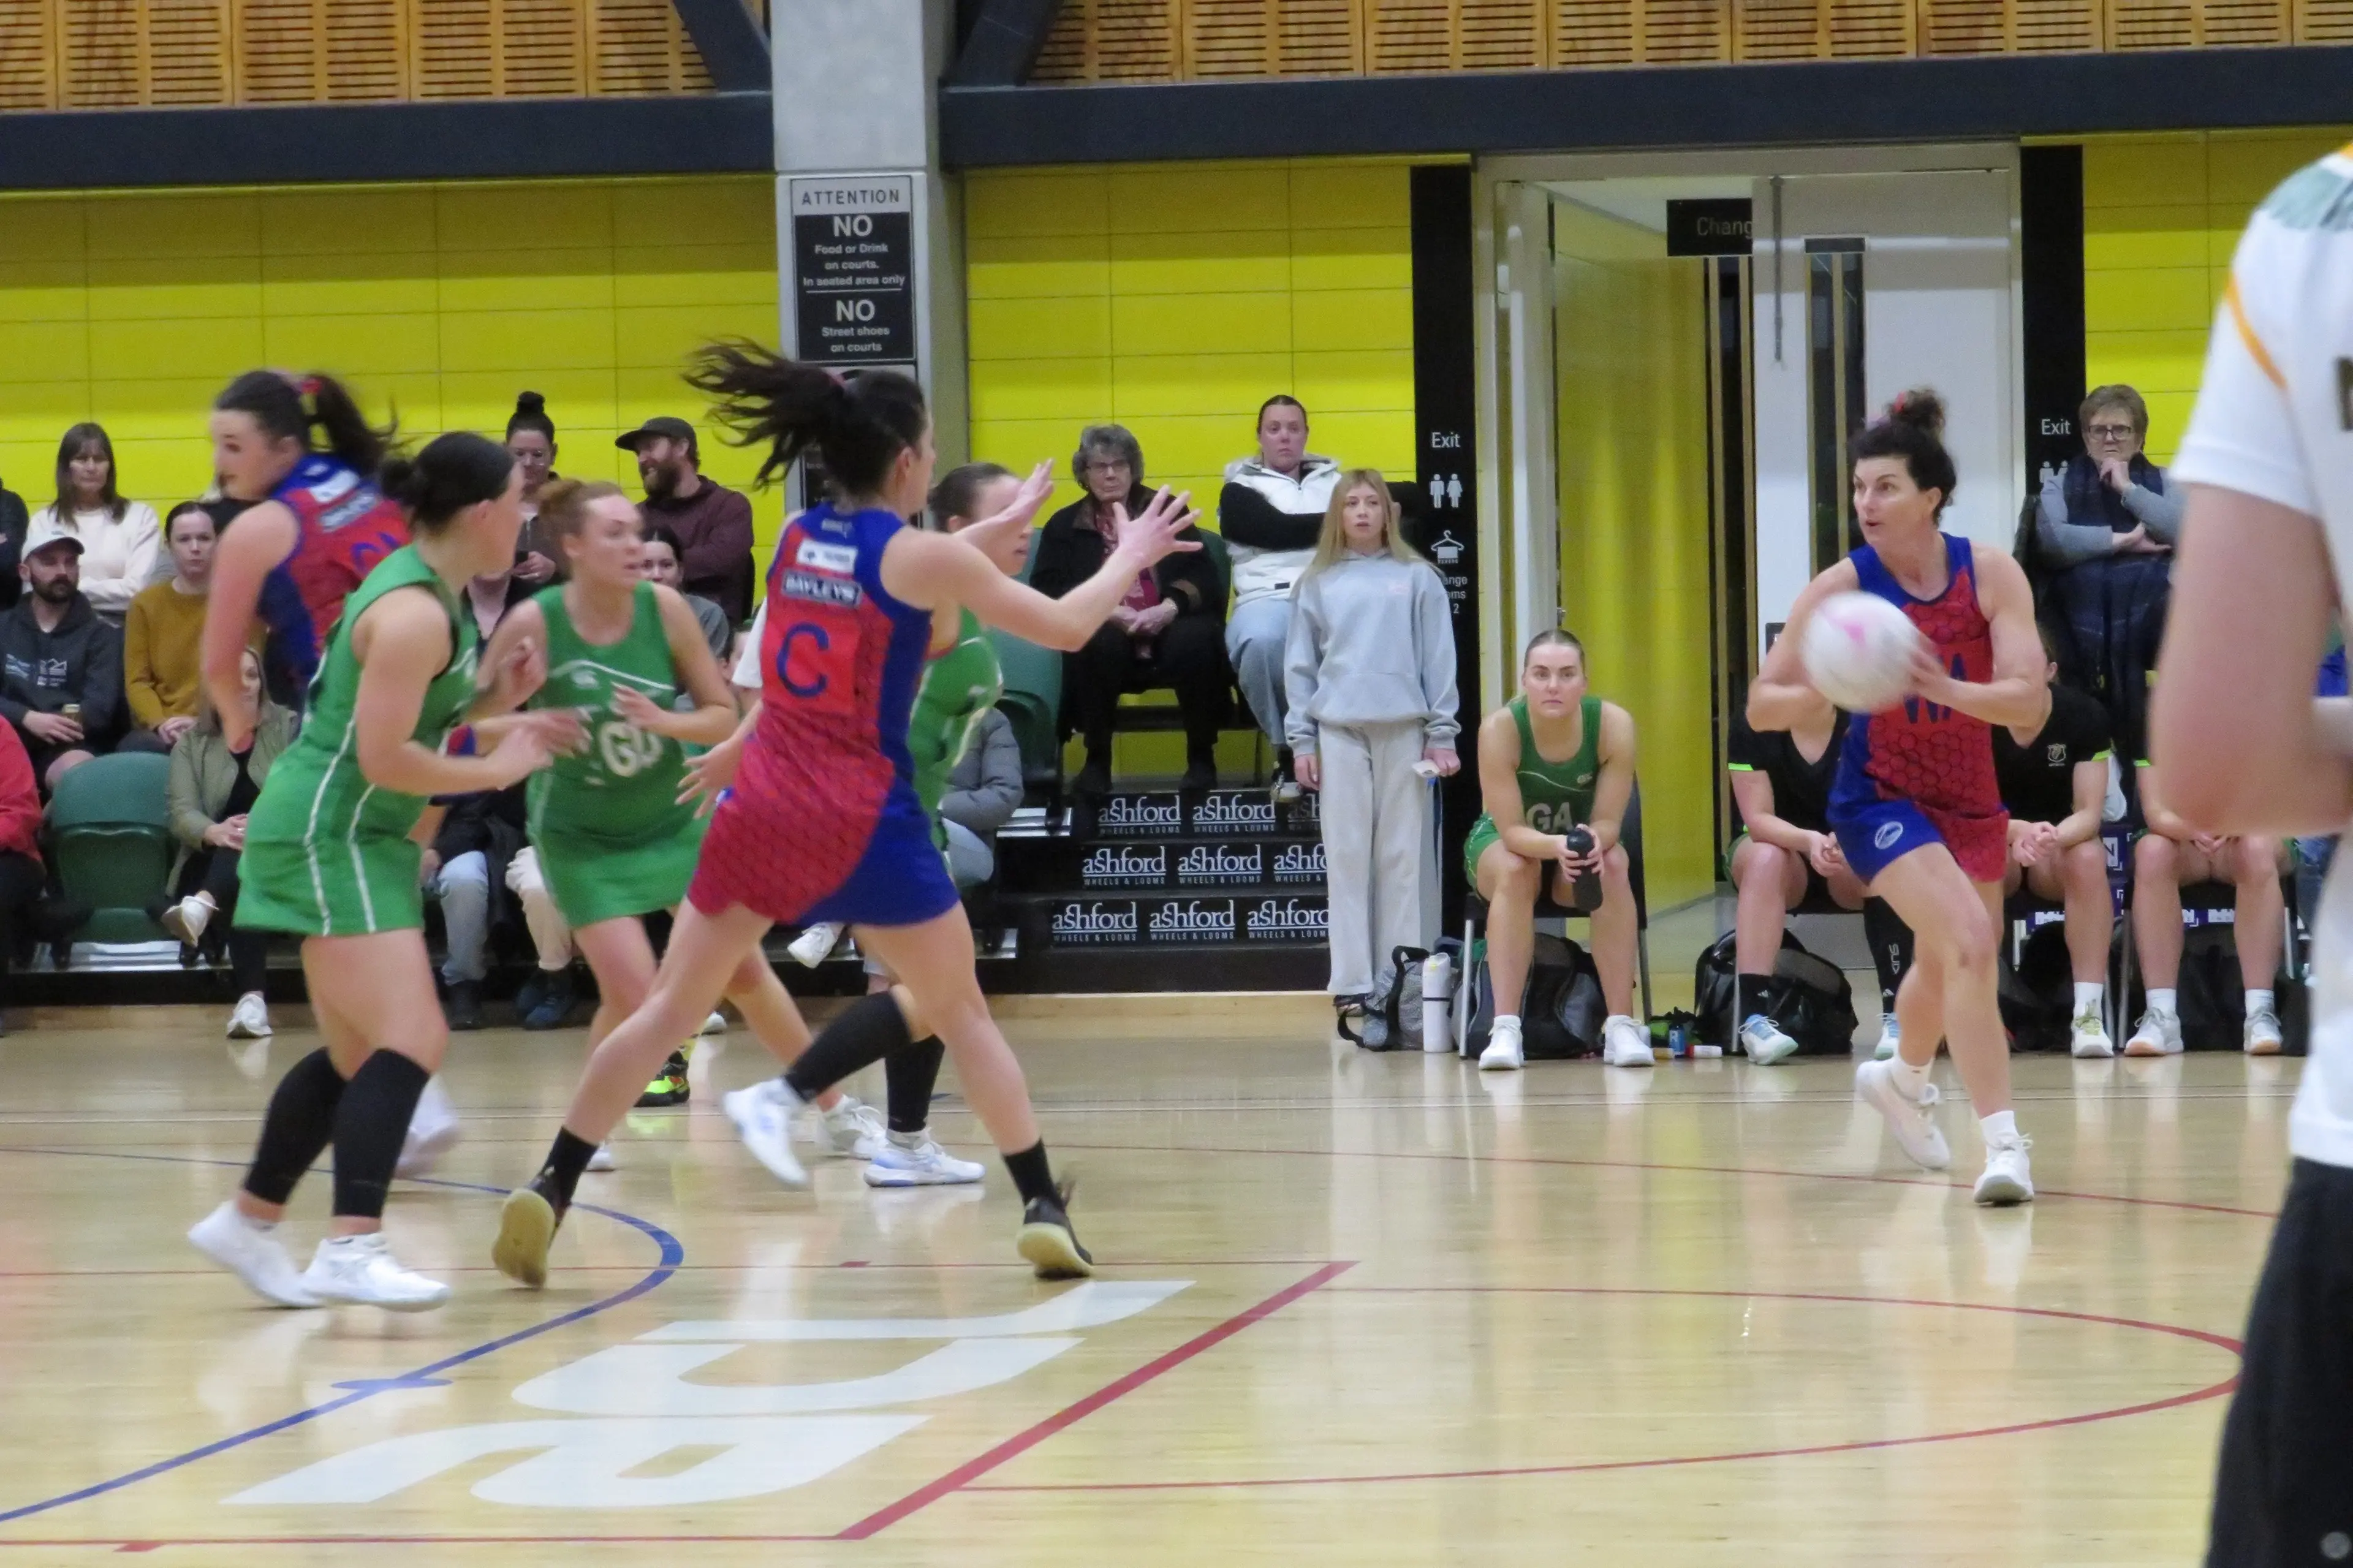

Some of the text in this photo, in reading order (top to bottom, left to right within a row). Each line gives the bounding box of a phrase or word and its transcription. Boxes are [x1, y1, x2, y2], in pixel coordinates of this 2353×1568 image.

[801, 189, 900, 205] ATTENTION
[833, 215, 873, 237] NO
[814, 244, 843, 254] Food
[859, 243, 889, 254] Drink
[841, 260, 880, 269] courts.
[803, 277, 814, 286] In
[816, 276, 852, 286] seated
[882, 275, 906, 286] only
[836, 300, 875, 322] NO
[822, 326, 890, 337] Street shoes
[847, 343, 882, 352] courts
[2040, 419, 2071, 435] Exit
[1431, 431, 1461, 448] Exit
[1442, 577, 1468, 587] ange
[1453, 603, 1460, 614] 2
[776, 623, 830, 698] C
[1098, 795, 1181, 822] ashford
[1192, 794, 1276, 820] ashford
[1526, 801, 1575, 834] GA
[1082, 846, 1166, 873] ashford
[1178, 844, 1262, 872] ashford
[1179, 876, 1215, 884] WHEELS
[1230, 875, 1261, 884] LOOMS
[1275, 874, 1311, 882] WHEELS
[1051, 901, 1138, 930] ashford
[1150, 900, 1235, 928] ashford
[1248, 930, 1285, 939] WHEELS
[1302, 929, 1326, 937] LOOM
